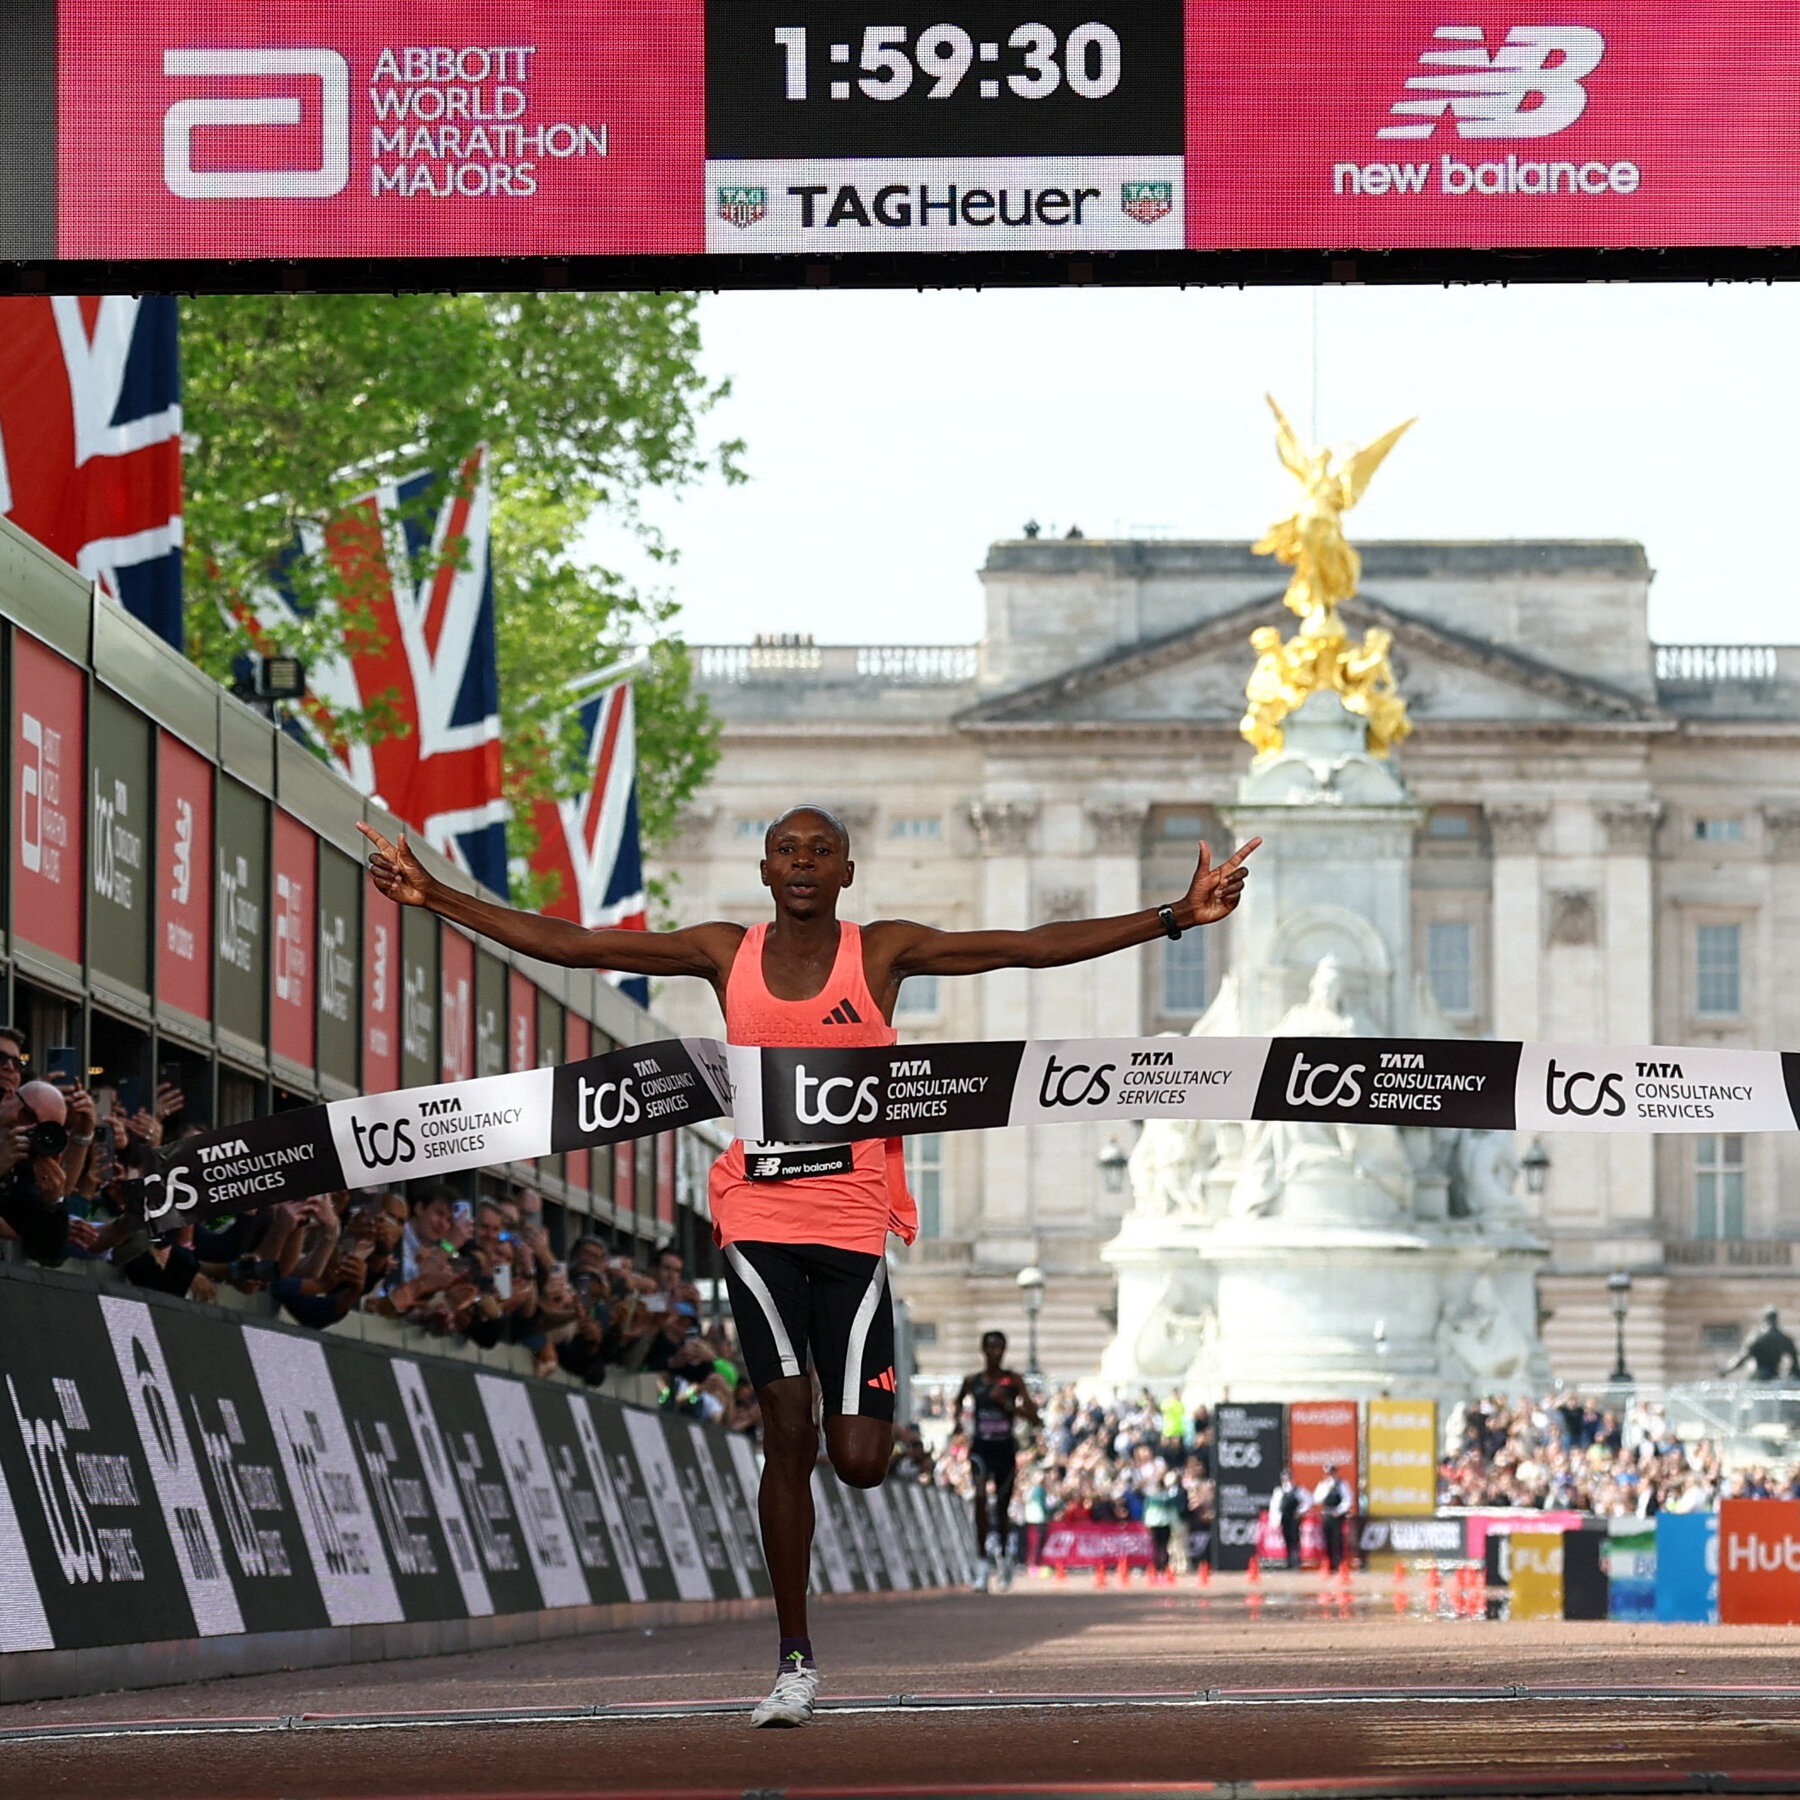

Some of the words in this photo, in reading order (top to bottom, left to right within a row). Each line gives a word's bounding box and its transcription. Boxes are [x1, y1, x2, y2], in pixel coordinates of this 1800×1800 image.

[372, 46, 536, 82] ABBOTT
[775, 22, 1121, 100] 1:59:30
[371, 86, 526, 119] WORLD
[371, 123, 608, 158] MARATHON
[371, 163, 538, 196] MAJORS
[1333, 161, 1430, 194] new
[1441, 154, 1641, 195] balance
[633, 1059, 662, 1078] TATA
[889, 1060, 931, 1077] TATA
[1130, 1052, 1174, 1066] TATA
[1379, 1053, 1424, 1069] TATA
[1635, 1062, 1684, 1079] TATA
[640, 1071, 695, 1098] CONSULTANCY
[887, 1076, 989, 1100] CONSULTANCY
[1039, 1054, 1116, 1108] tcs
[1123, 1070, 1233, 1085] CONSULTANCY
[1285, 1052, 1366, 1107] tcs
[1373, 1073, 1486, 1092] CONSULTANCY
[1546, 1058, 1626, 1117] tcs
[577, 1076, 641, 1132] tcs
[795, 1064, 880, 1125] tcs
[1117, 1089, 1186, 1105] SERVICES
[1368, 1092, 1442, 1111] SERVICES
[1634, 1083, 1753, 1101] CONSULTANCY
[418, 1097, 462, 1117] TATA
[646, 1094, 689, 1119] SERVICES
[885, 1100, 948, 1121] SERVICES
[1637, 1104, 1714, 1119] SERVICES
[420, 1107, 522, 1138] CONSULTANCY
[197, 1139, 250, 1164] TATA
[351, 1115, 416, 1169] tcs
[424, 1134, 485, 1159] SERVICES
[203, 1143, 315, 1184] CONSULTANCY
[782, 1165, 801, 1175] new
[803, 1161, 842, 1173] balance
[208, 1171, 286, 1203] SERVICES
